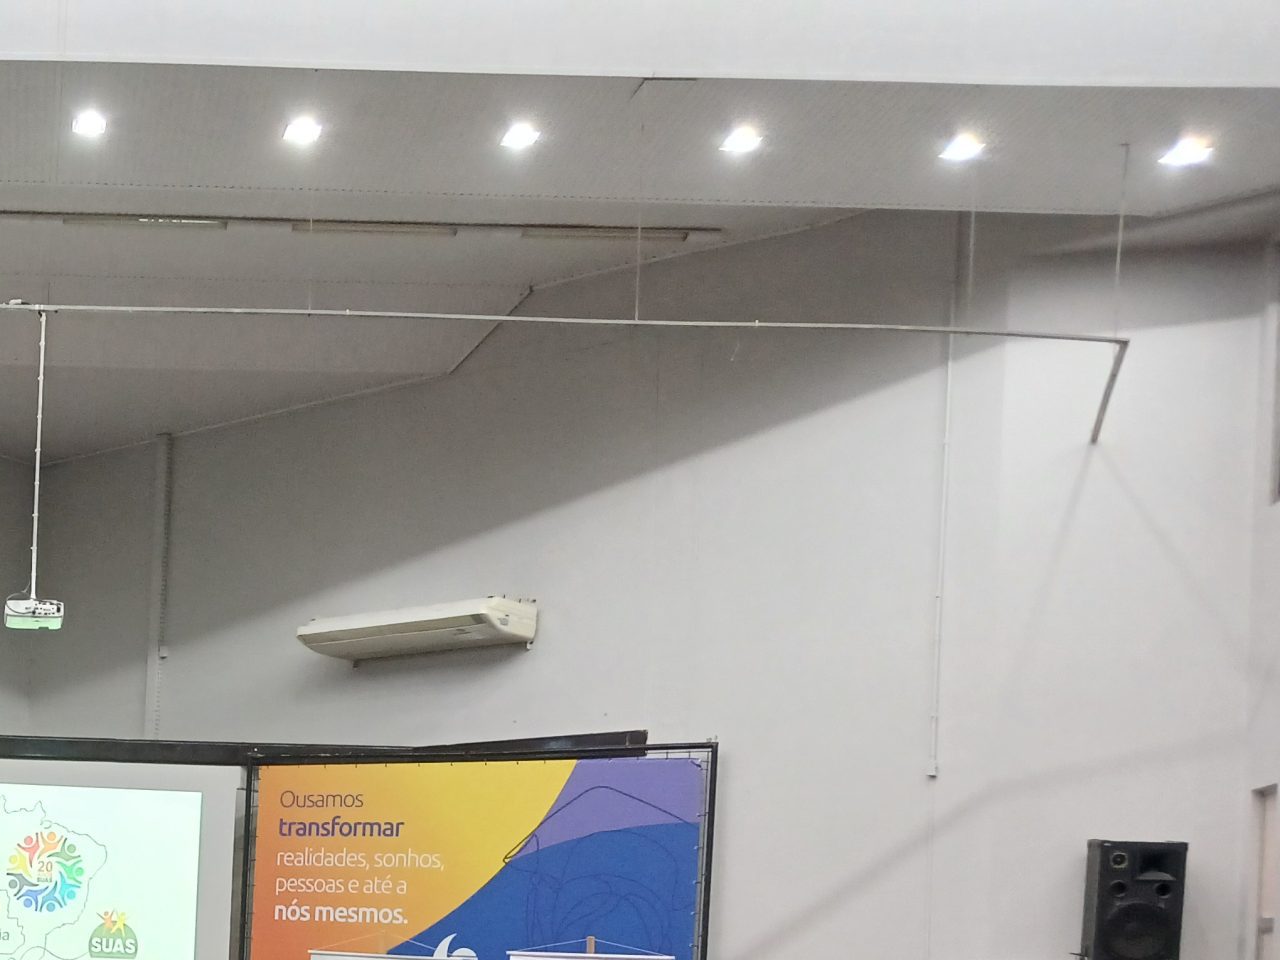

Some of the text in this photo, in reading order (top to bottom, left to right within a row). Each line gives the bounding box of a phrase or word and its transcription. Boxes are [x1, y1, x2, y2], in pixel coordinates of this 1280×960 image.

[280, 790, 364, 809] Ousamos
[279, 815, 405, 837] transformar
[276, 847, 445, 871] realidades, sonhos,
[275, 874, 408, 896] pessoas e até a
[274, 898, 409, 925] nós mesmos.
[91, 936, 136, 954] SUAS
